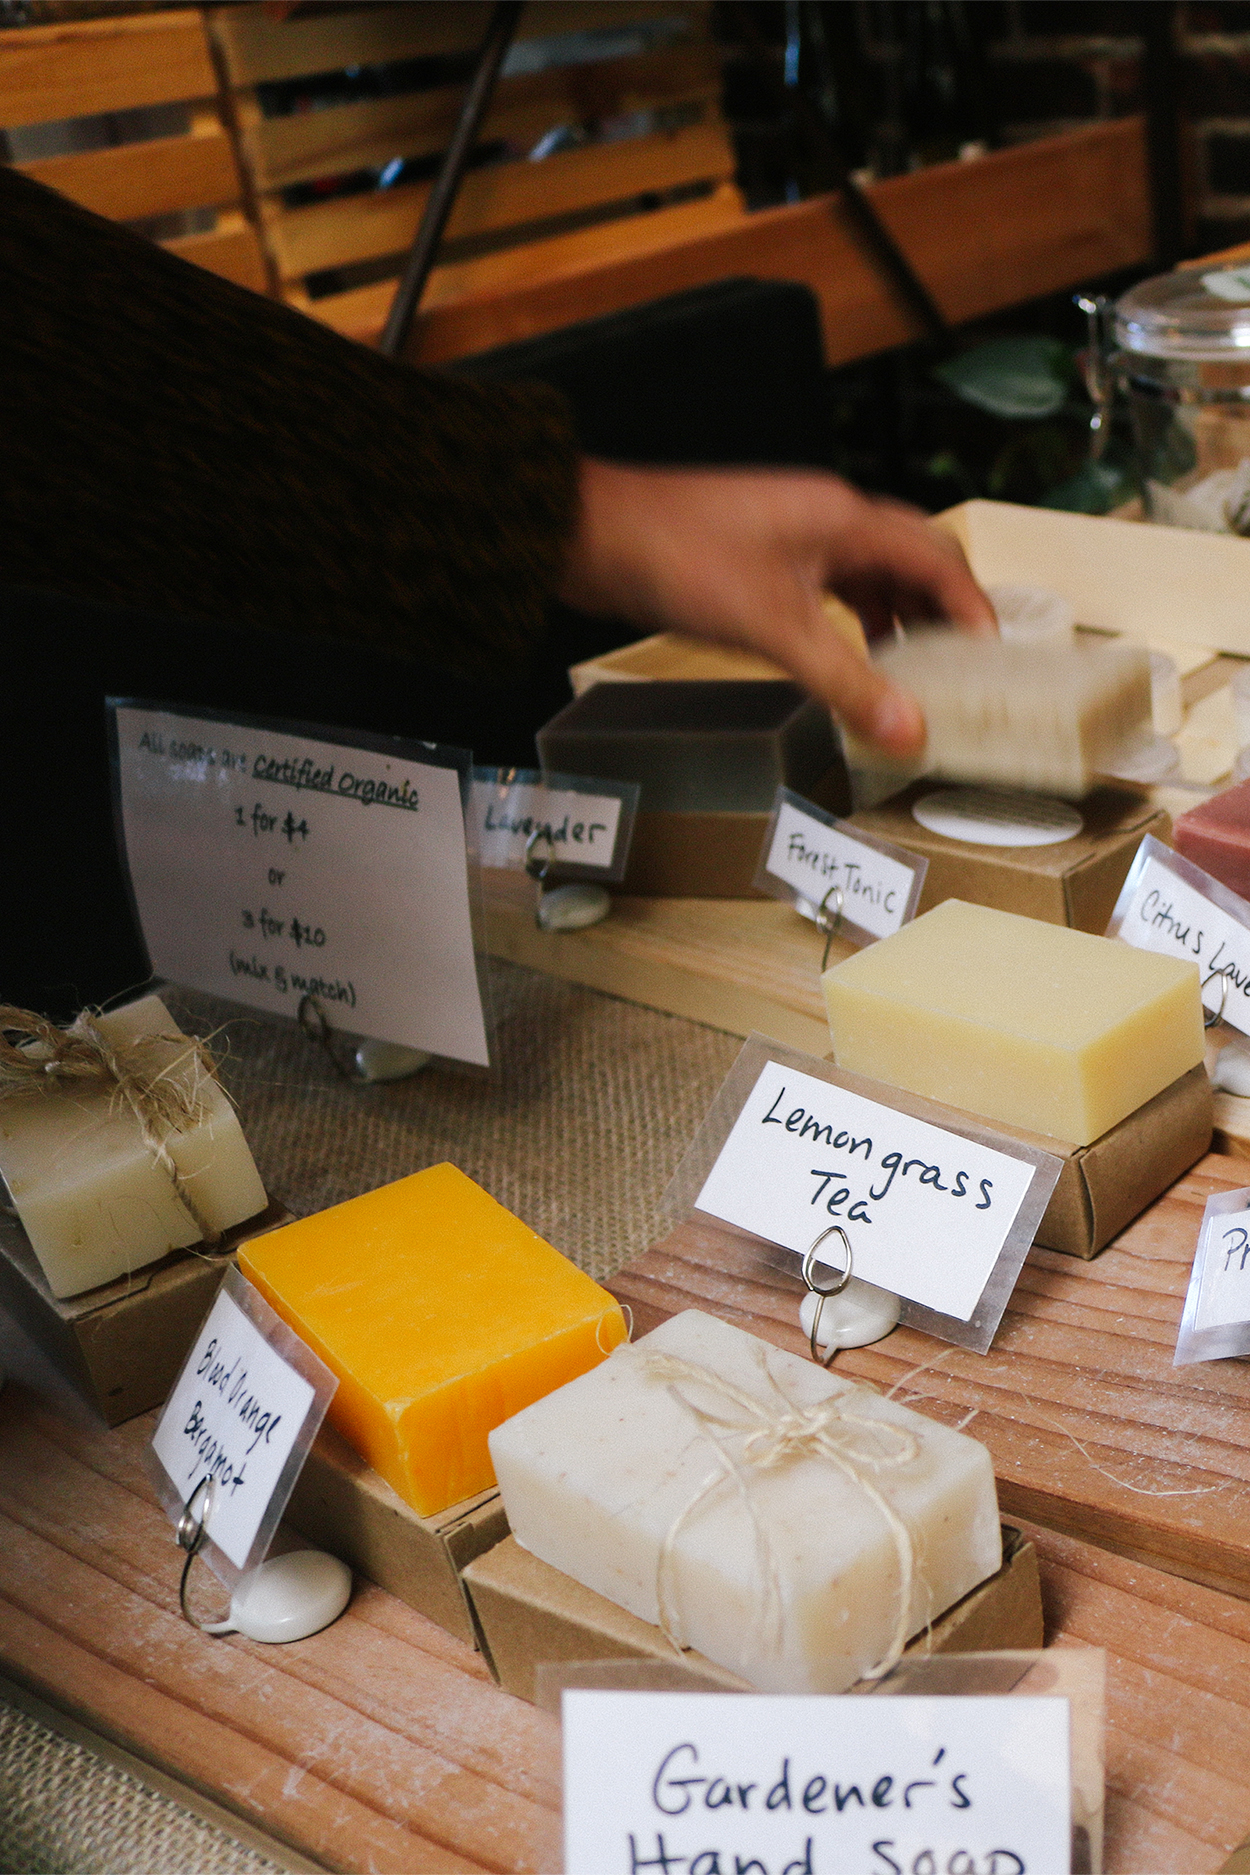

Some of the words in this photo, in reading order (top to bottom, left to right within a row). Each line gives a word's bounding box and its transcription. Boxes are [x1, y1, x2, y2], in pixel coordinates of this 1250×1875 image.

[252, 754, 333, 790] Certified
[337, 770, 419, 807] Organic
[234, 806, 246, 826] 1
[253, 803, 278, 837] for
[281, 810, 310, 843] $4
[268, 867, 286, 887] or
[788, 832, 839, 880] Forest
[843, 863, 896, 914] Tonic
[242, 909, 255, 929] 3
[259, 907, 285, 940] for
[289, 917, 327, 948] $10
[1140, 888, 1205, 955] Citrus
[811, 1169, 872, 1225] Tea
[197, 1338, 242, 1397] Blood
[228, 1372, 283, 1456] Orange
[184, 1400, 247, 1497] Bergamot
[651, 1742, 972, 1816] Gardener's
